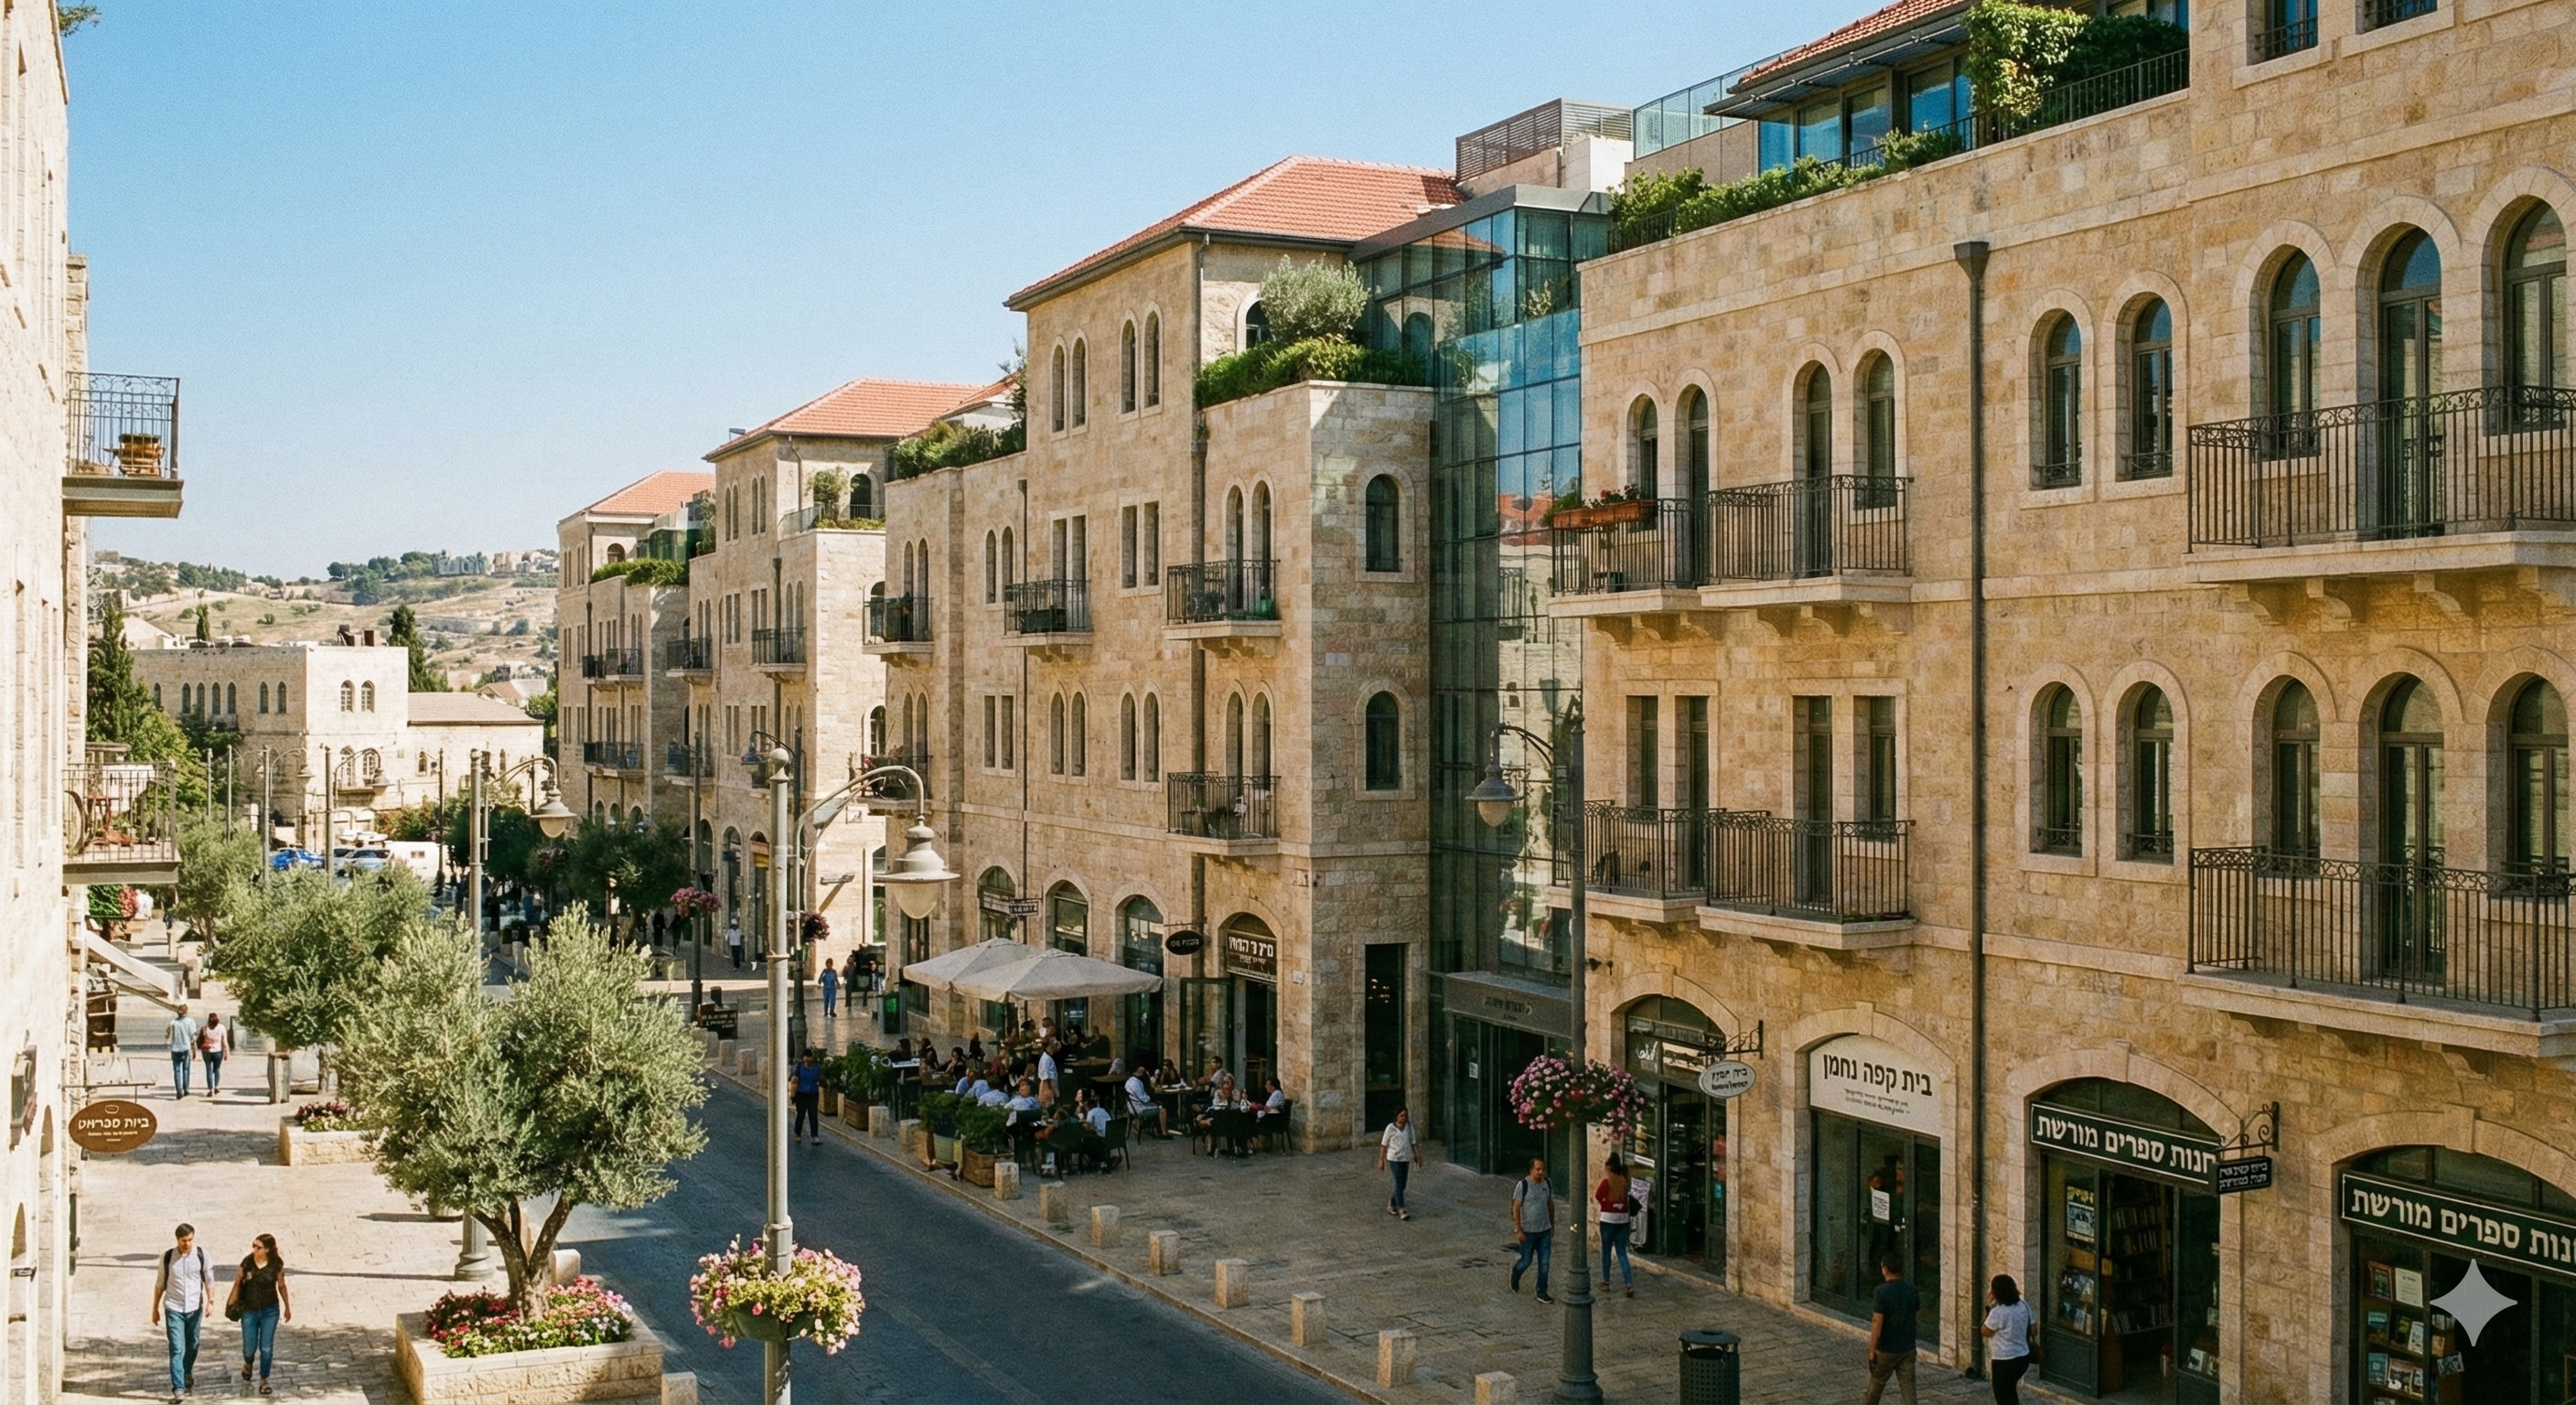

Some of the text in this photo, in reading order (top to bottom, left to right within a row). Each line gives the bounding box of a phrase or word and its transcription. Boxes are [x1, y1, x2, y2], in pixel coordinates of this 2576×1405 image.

[1823, 1054, 1933, 1097] בית קפה נחמן
[2036, 1115, 2098, 1148] מורשת
[2105, 1131, 2165, 1164] ספרים
[2169, 1144, 2217, 1174] חנות
[2351, 1188, 2576, 1264] נות ספרים מורשת
